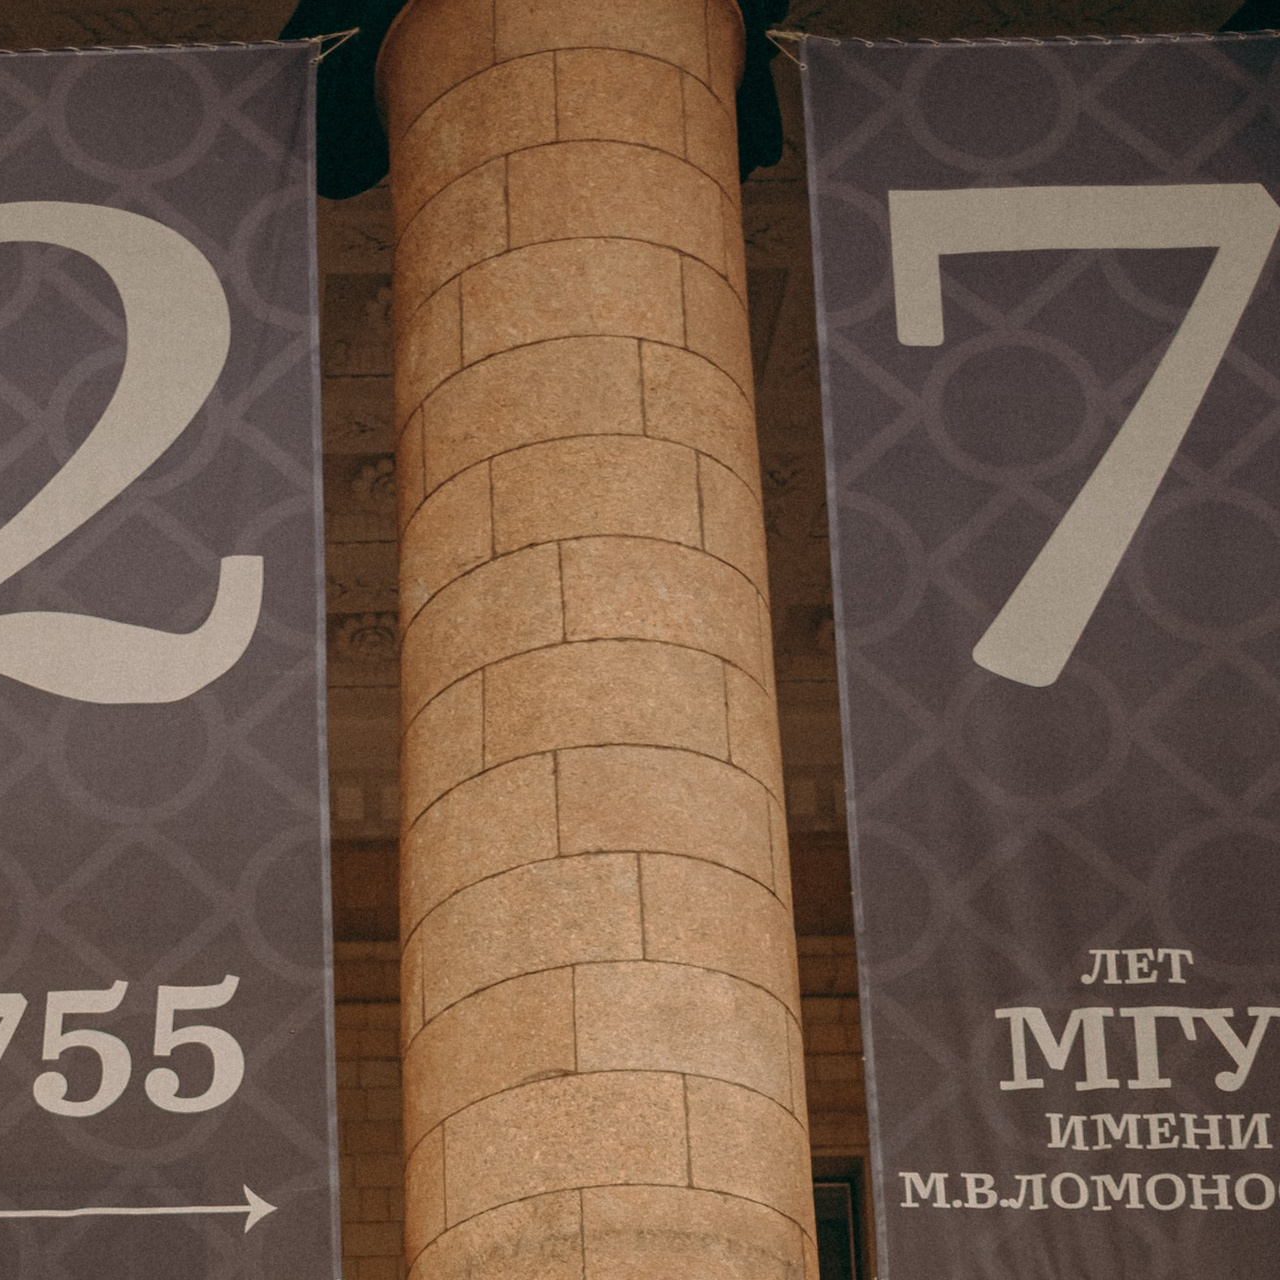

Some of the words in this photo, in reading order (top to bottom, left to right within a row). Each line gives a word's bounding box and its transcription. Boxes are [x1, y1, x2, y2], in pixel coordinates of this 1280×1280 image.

[888, 183, 1280, 688] 7
[1080, 947, 1194, 985] ЛЕТ
[994, 1005, 1280, 1092] МГУ
[1044, 1112, 1274, 1152] ИМЕНИ
[897, 1171, 1280, 1211] М.В.ЛОМОНО
